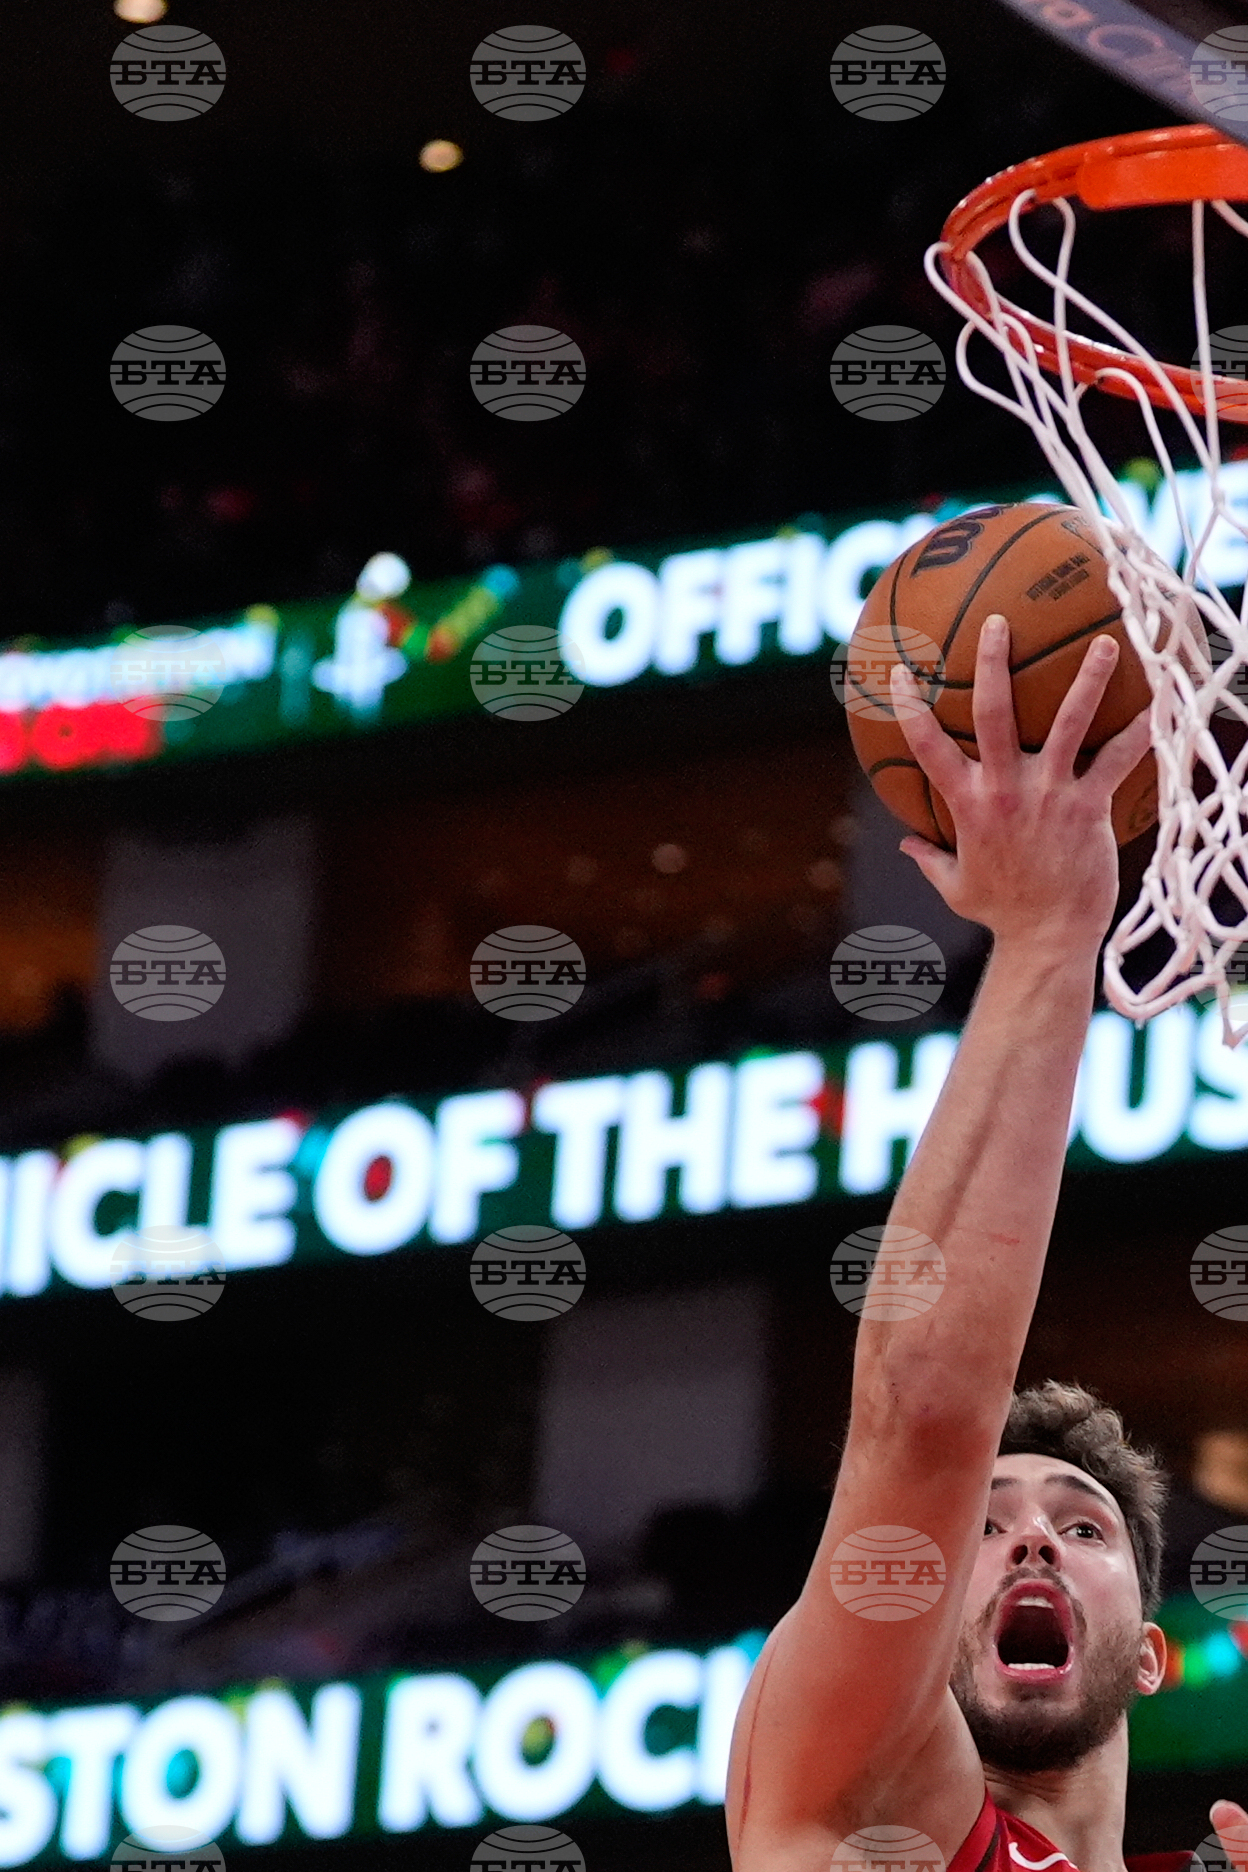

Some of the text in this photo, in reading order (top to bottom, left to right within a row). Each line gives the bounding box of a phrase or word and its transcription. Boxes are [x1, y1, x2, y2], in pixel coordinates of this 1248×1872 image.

[557, 511, 945, 688] OFFIC
[0, 1119, 300, 1297] ICLE
[313, 1088, 527, 1256] OF
[532, 1050, 824, 1230] THE
